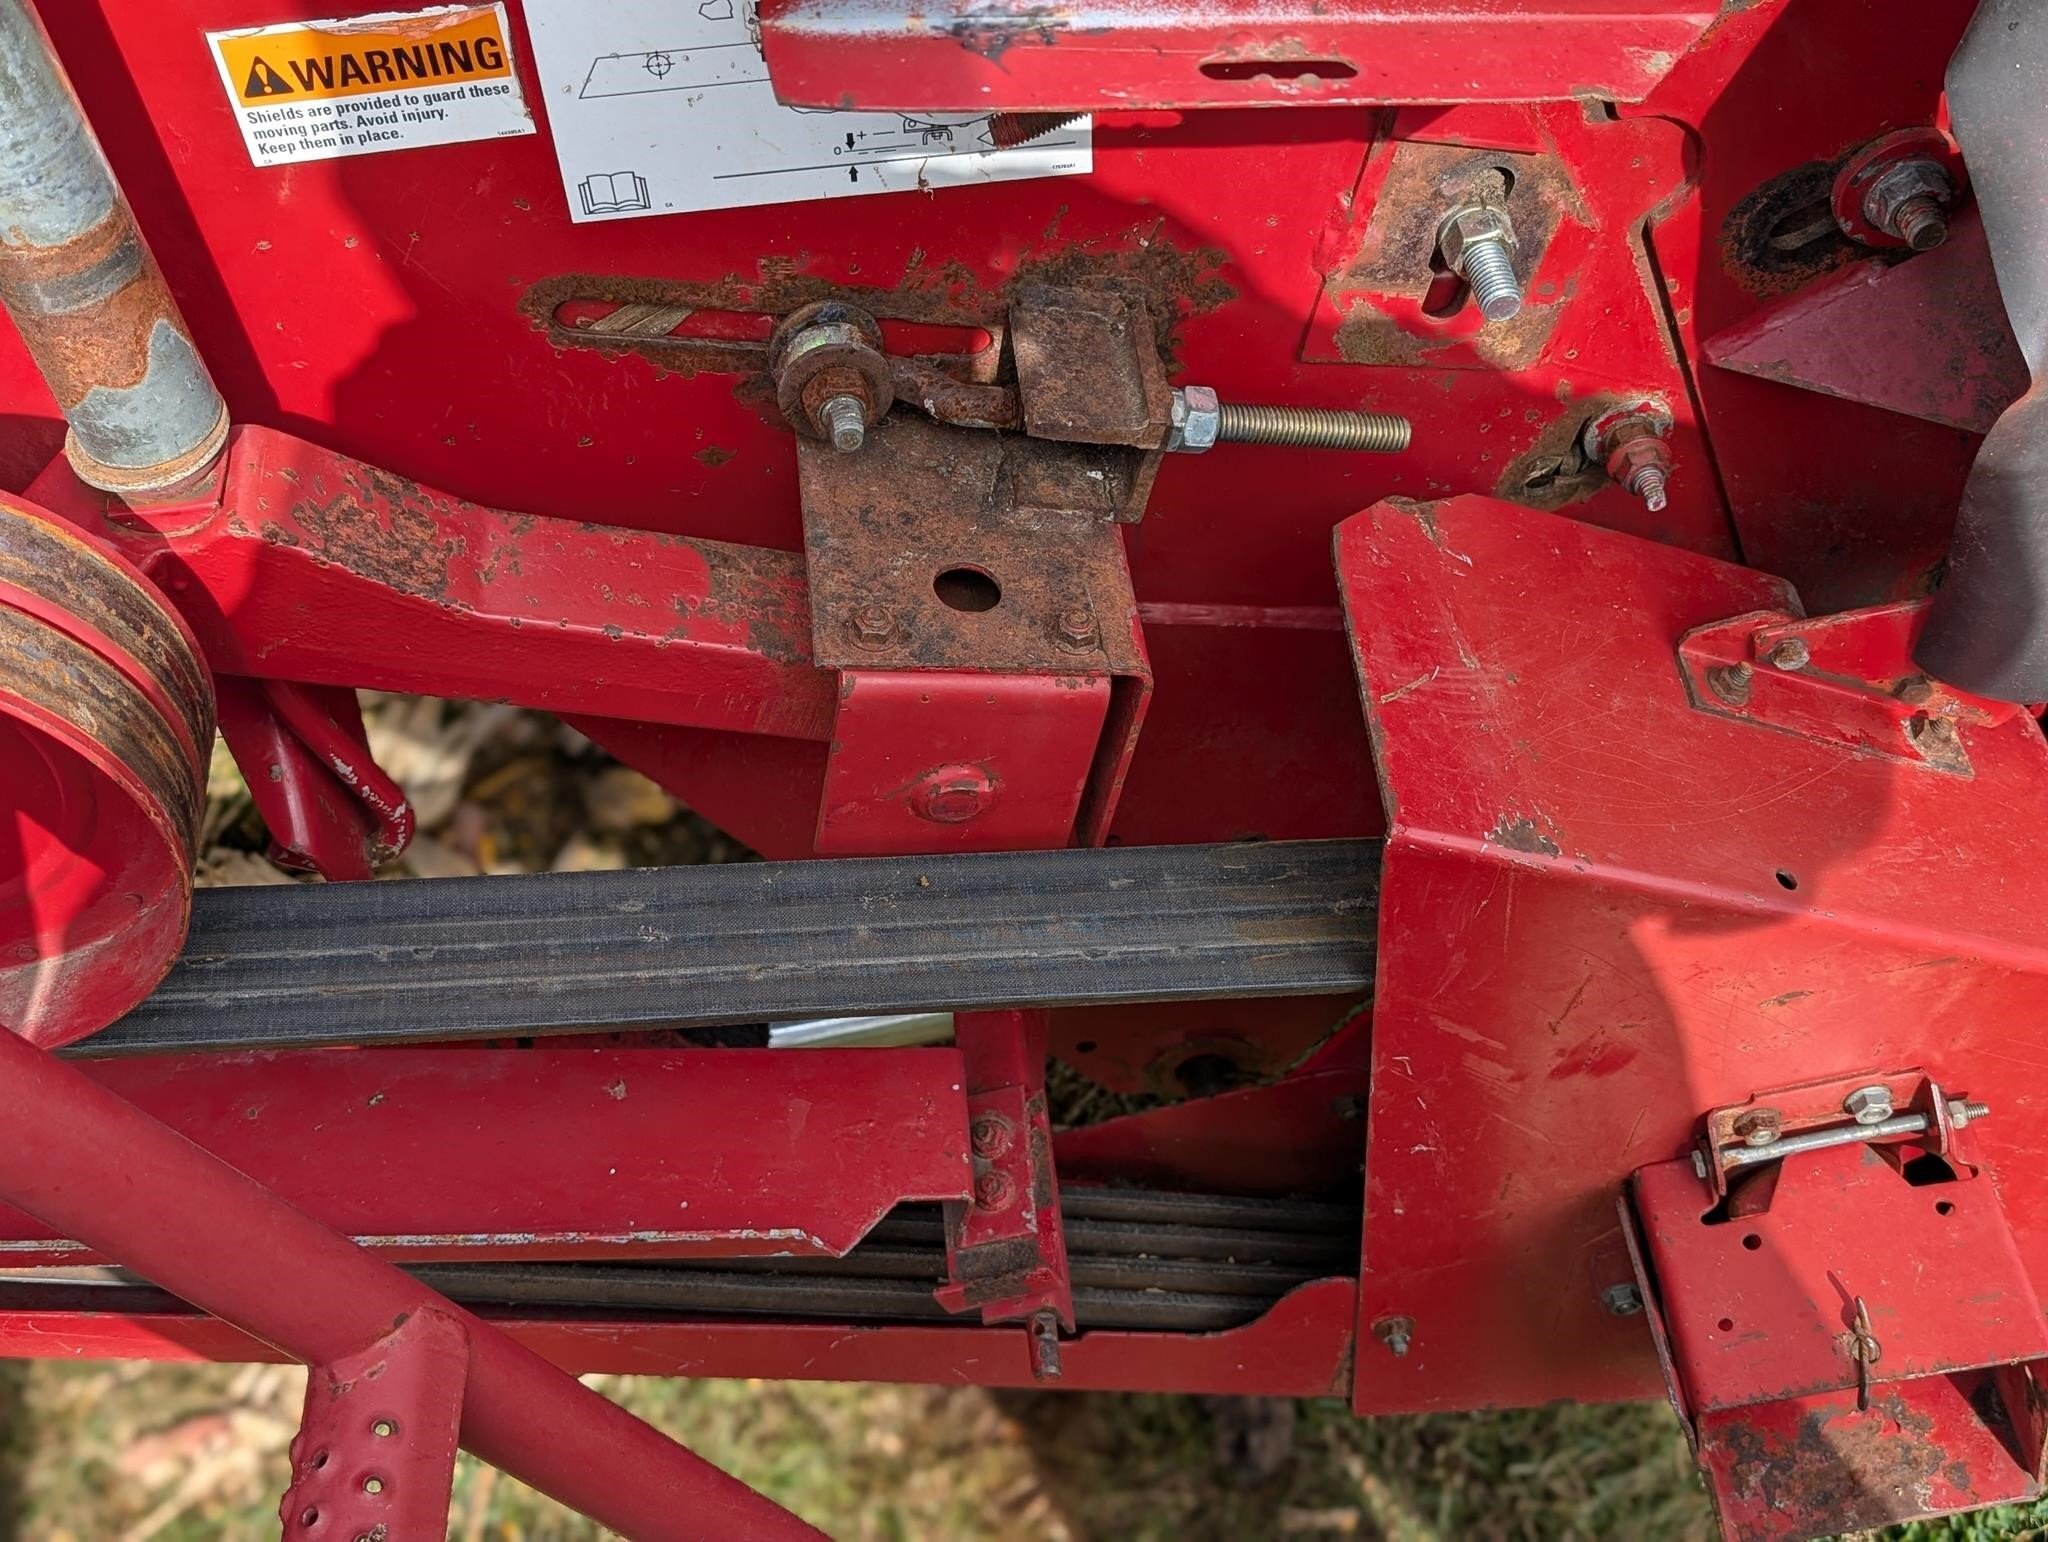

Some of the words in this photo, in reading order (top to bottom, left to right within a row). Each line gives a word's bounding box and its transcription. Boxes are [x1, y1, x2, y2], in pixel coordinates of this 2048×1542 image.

[288, 37, 503, 92] WARNING
[247, 107, 304, 124] Shields
[308, 105, 332, 121] are
[335, 95, 402, 117] provided
[404, 94, 420, 106] to
[423, 87, 466, 106] guard
[469, 84, 510, 98] these
[253, 124, 308, 140] moving
[311, 119, 353, 136] parts.
[357, 111, 399, 128] Avoid
[401, 108, 449, 123] injury.
[258, 142, 296, 155] Keep
[299, 138, 337, 151] them
[339, 133, 354, 146] in
[358, 129, 404, 146] place.
